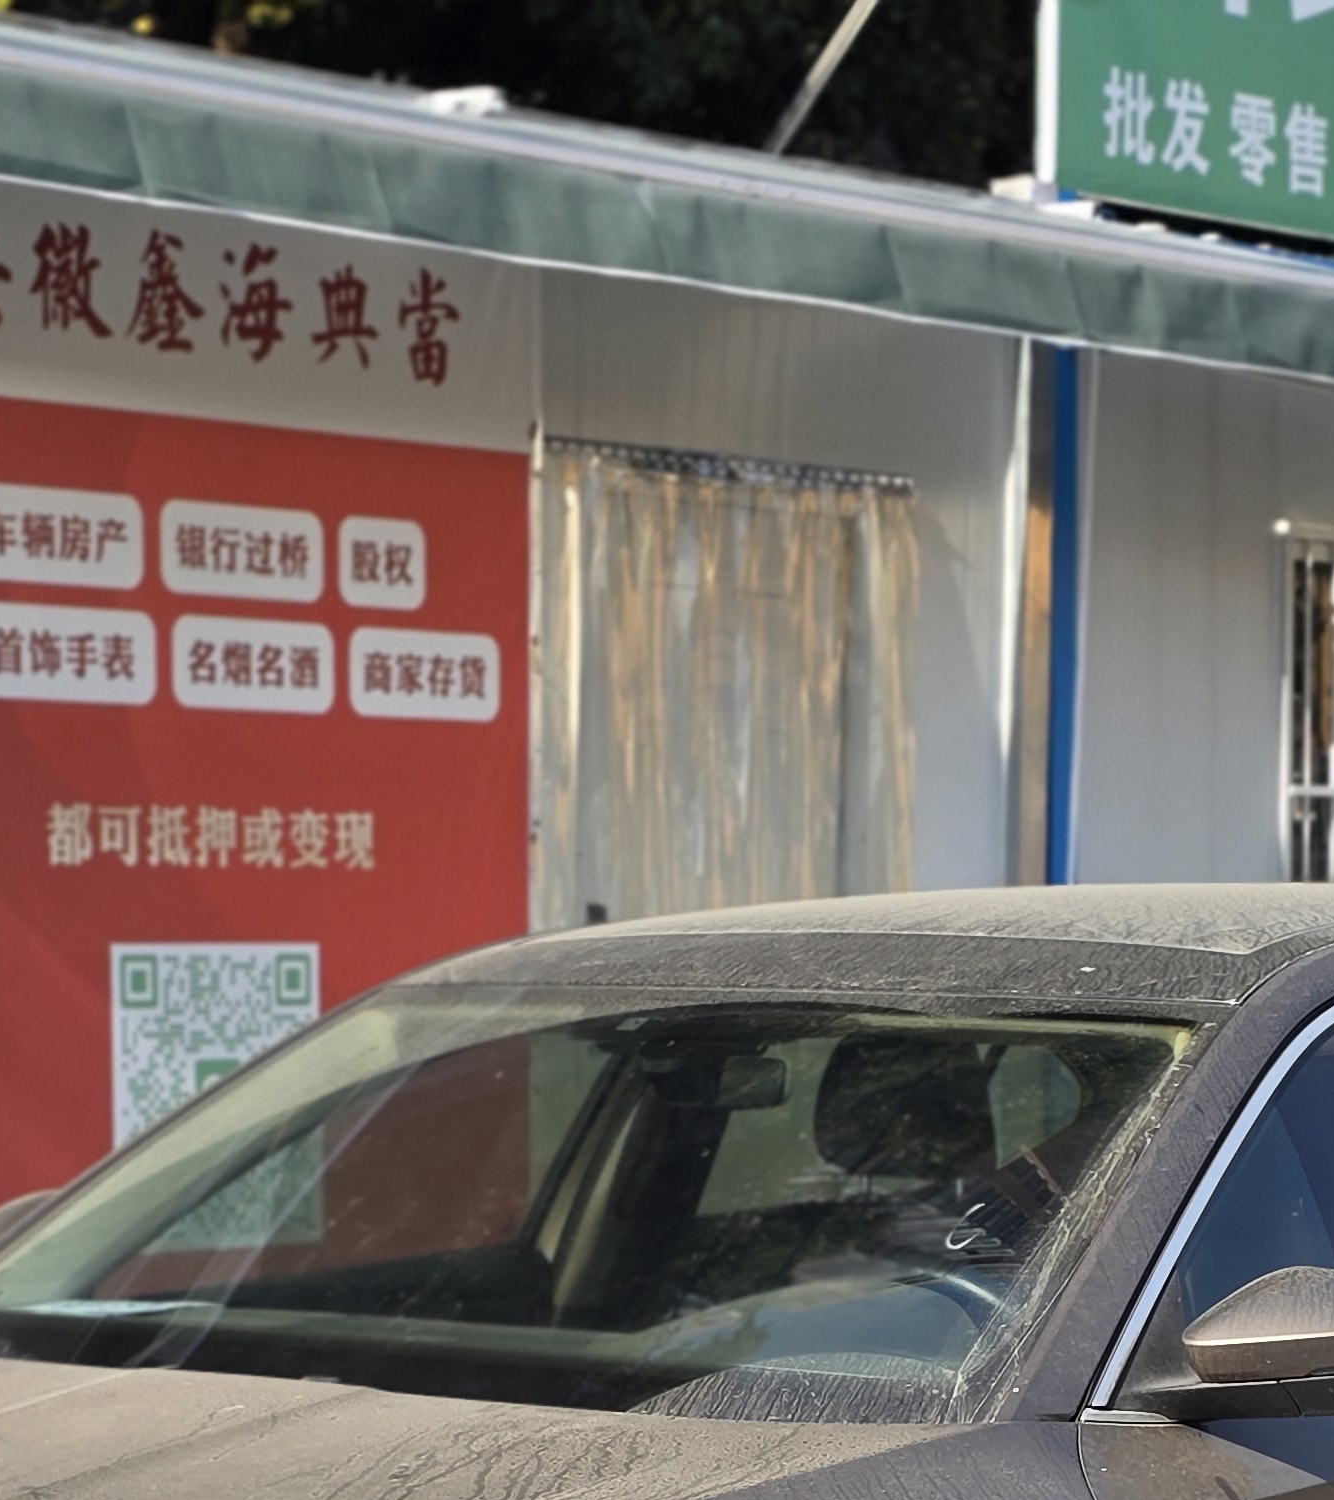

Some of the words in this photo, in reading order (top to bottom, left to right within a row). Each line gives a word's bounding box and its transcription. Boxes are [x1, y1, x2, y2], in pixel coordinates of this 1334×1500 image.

[1103, 66, 1210, 176] 批发
[1229, 91, 1328, 197] 零售
[175, 524, 309, 581] 银行过桥
[351, 540, 415, 588] 股权
[189, 640, 321, 690] 名烟名酒
[362, 651, 487, 700] 商家存货
[47, 802, 375, 870] 都可抵押或变现
